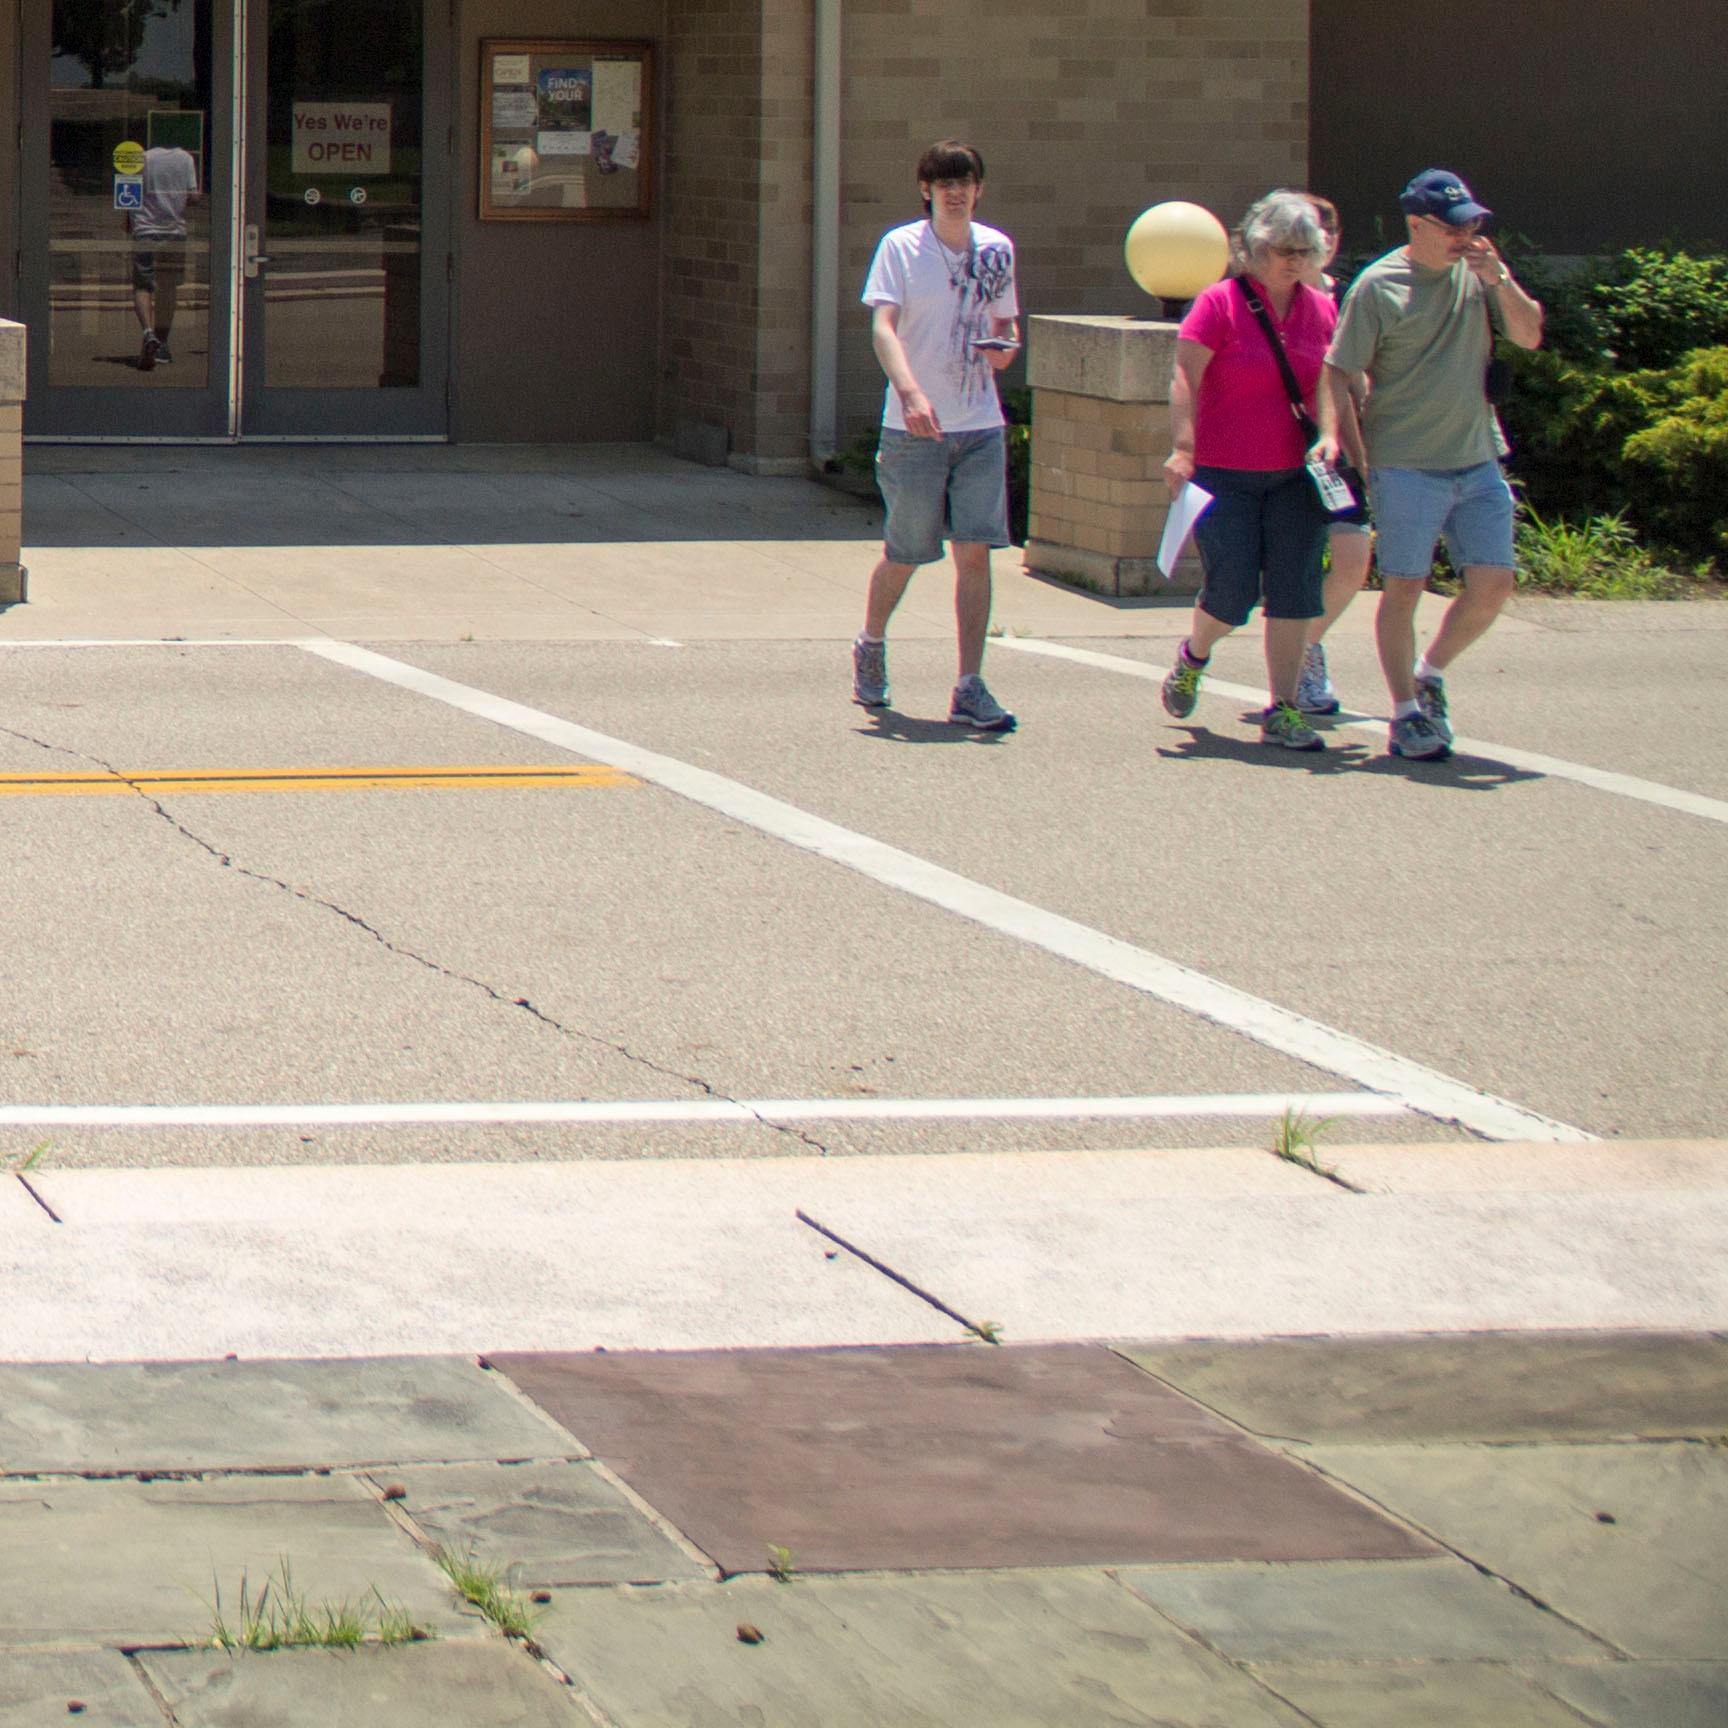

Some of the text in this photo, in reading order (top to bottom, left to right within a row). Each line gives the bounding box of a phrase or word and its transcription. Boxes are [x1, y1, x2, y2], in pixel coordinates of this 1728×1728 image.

[547, 78, 578, 89] FIND
[548, 90, 584, 101] YOUR
[294, 114, 388, 130] Yes We're
[308, 142, 372, 161] OPEN
